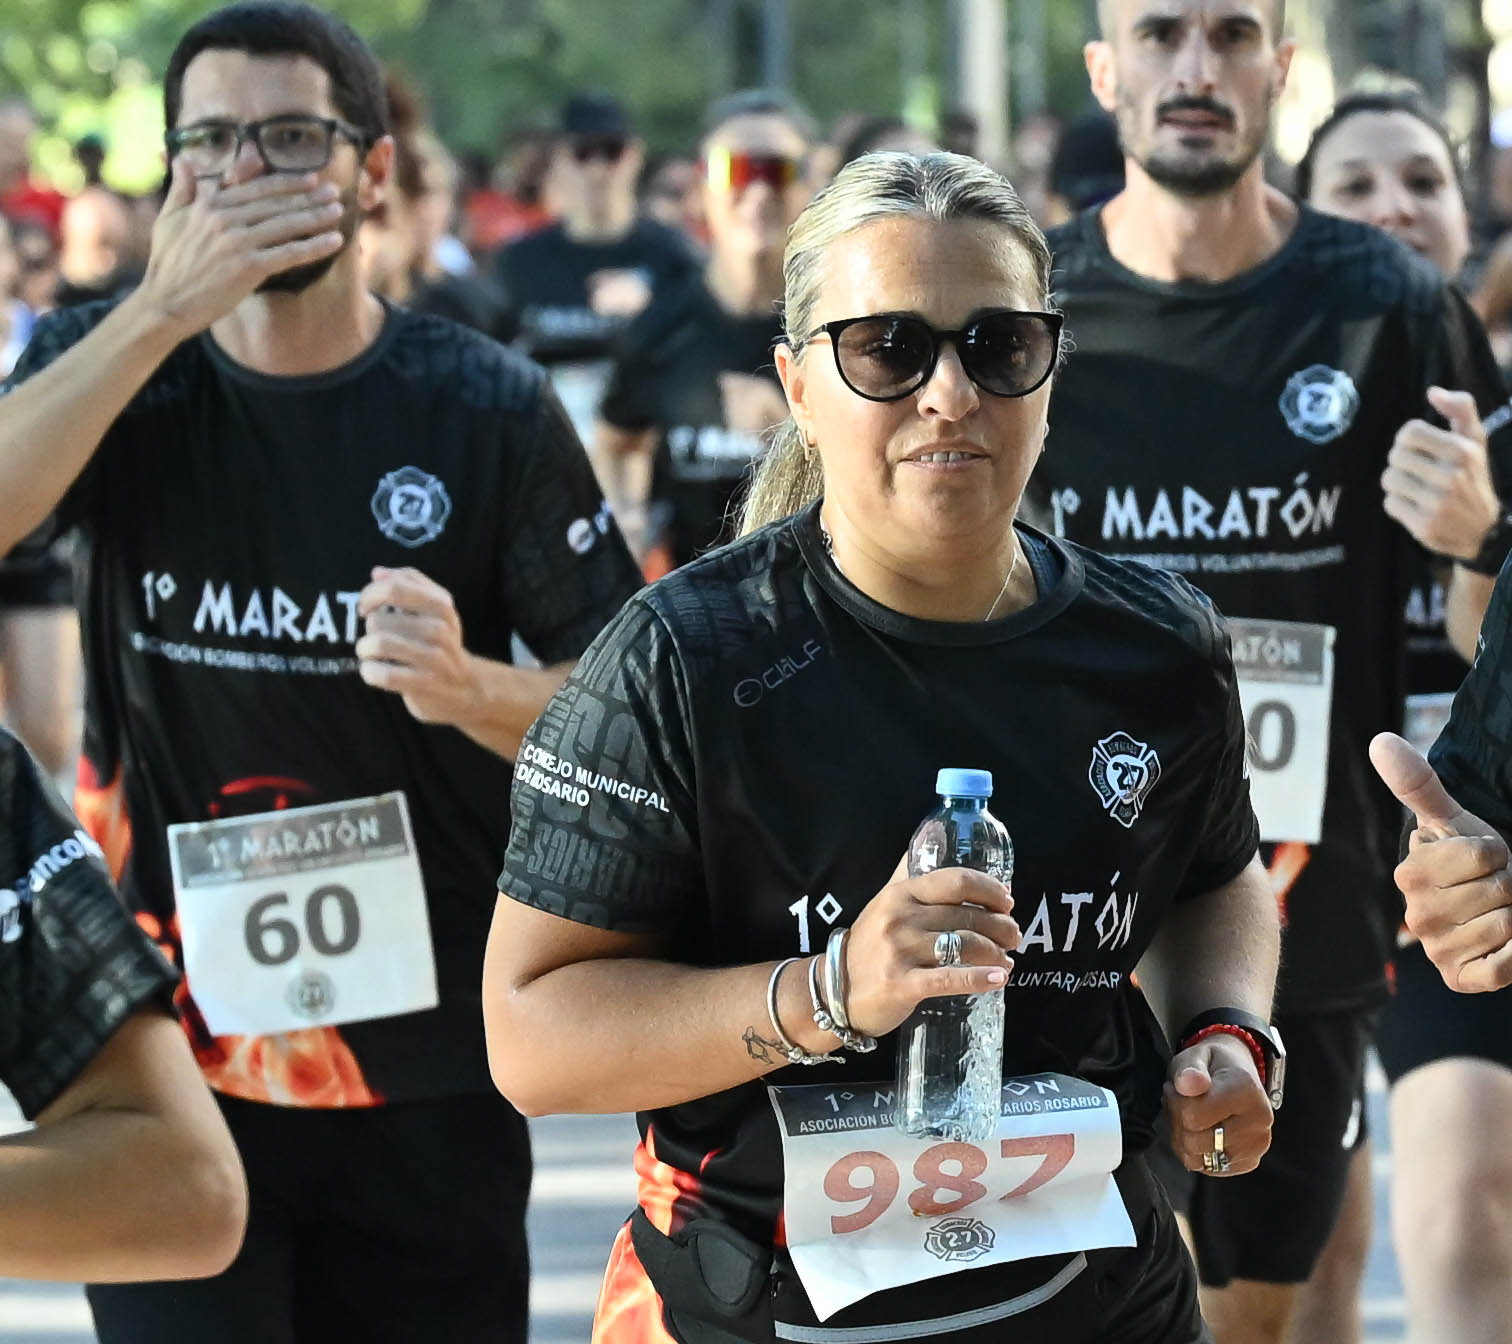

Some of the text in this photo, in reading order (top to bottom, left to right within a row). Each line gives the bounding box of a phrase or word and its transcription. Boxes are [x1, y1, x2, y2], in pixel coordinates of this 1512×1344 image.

[1100, 472, 1342, 541] MARATÓN
[192, 577, 362, 644] MARAT
[1235, 628, 1302, 668] ATÓN
[575, 766, 670, 813] MUNICIPAL
[1111, 761, 1146, 792] 27
[240, 812, 381, 861] MARATÓN
[243, 883, 360, 967] 60
[1017, 869, 1139, 955] ATÓN
[1044, 1094, 1101, 1111] ROSARIO
[823, 1132, 1076, 1235] 987
[945, 1230, 973, 1248] 27
